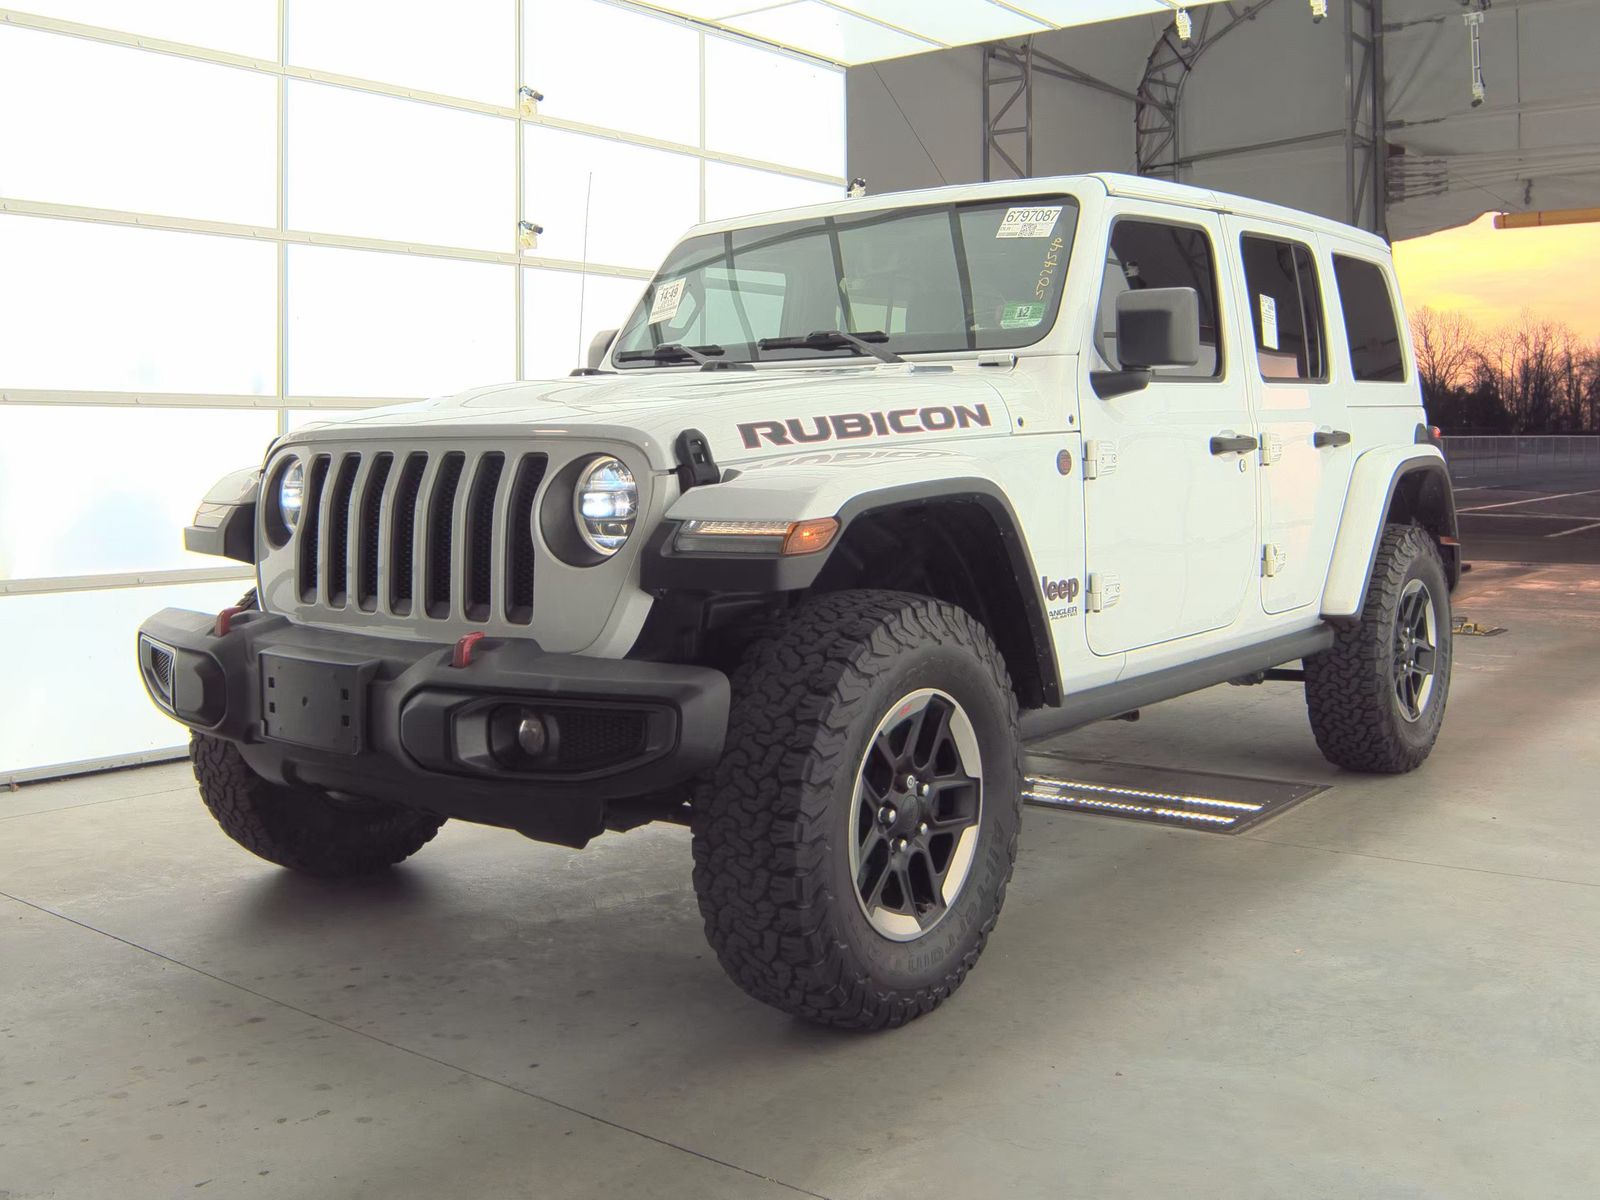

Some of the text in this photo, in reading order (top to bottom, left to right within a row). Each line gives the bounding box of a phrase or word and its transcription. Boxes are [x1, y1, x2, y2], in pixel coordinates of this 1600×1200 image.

[1006, 210, 1060, 223] 6797087
[1017, 306, 1029, 318] 12
[736, 403, 992, 449] RUBICON
[1048, 606, 1077, 617] ANGLER
